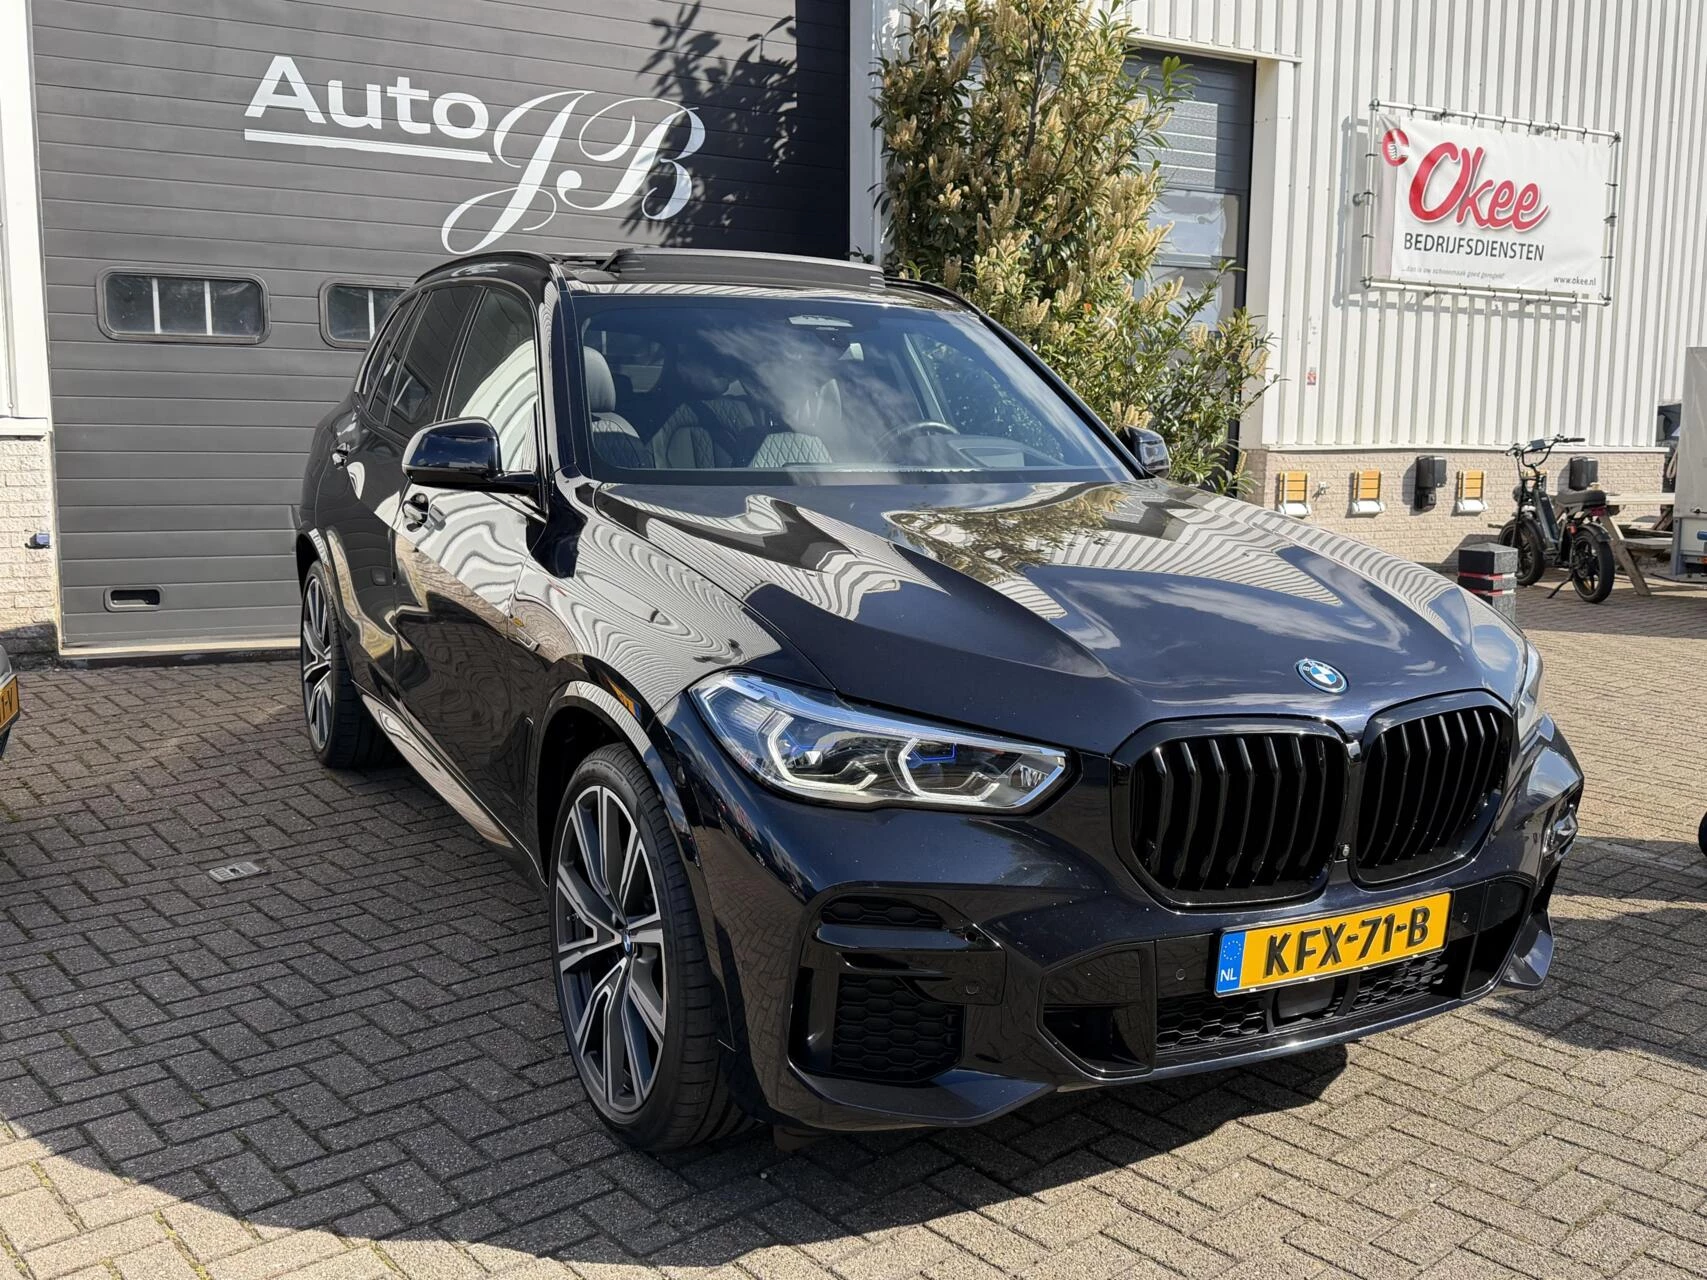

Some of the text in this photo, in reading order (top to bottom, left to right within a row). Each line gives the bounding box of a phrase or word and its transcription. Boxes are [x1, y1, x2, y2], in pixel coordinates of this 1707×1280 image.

[244, 55, 706, 254] Auto JB
[1408, 142, 1549, 231] Okee
[1403, 232, 1545, 262] BEDRIJFSDIENSTEN
[1553, 276, 1596, 286] www.okee.nl
[1263, 906, 1431, 979] KFX-71-B
[1219, 970, 1238, 982] NL
